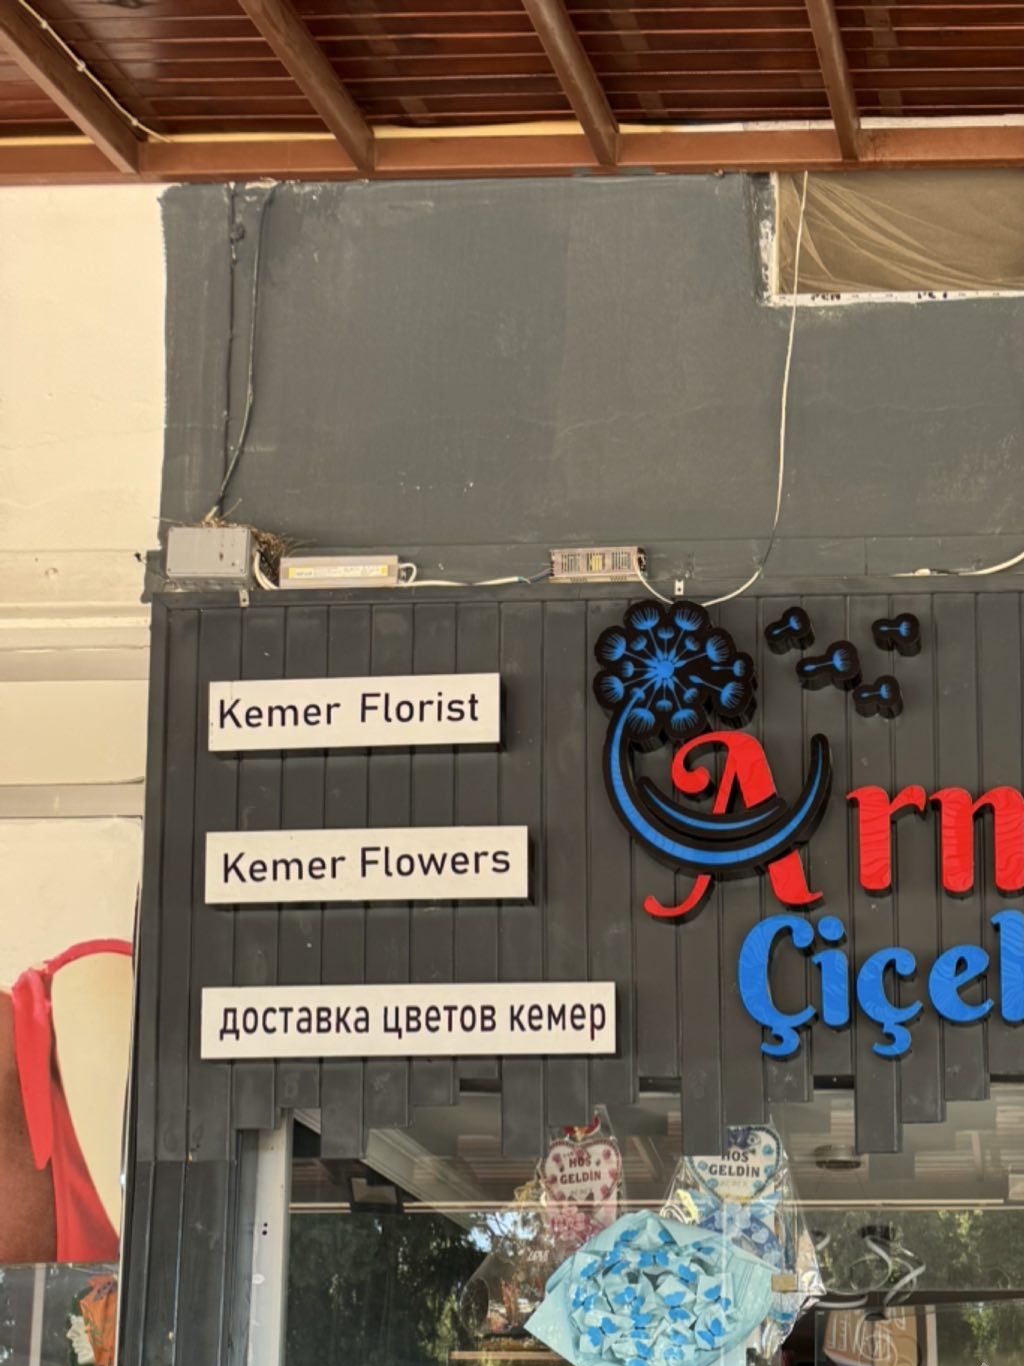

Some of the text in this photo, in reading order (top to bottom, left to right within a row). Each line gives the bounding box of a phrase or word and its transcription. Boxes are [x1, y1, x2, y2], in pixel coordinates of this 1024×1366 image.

[218, 692, 480, 729] Kemer Florist
[223, 846, 511, 883] Kemer Flowers
[219, 1002, 607, 1040] доставка цветов кемер
